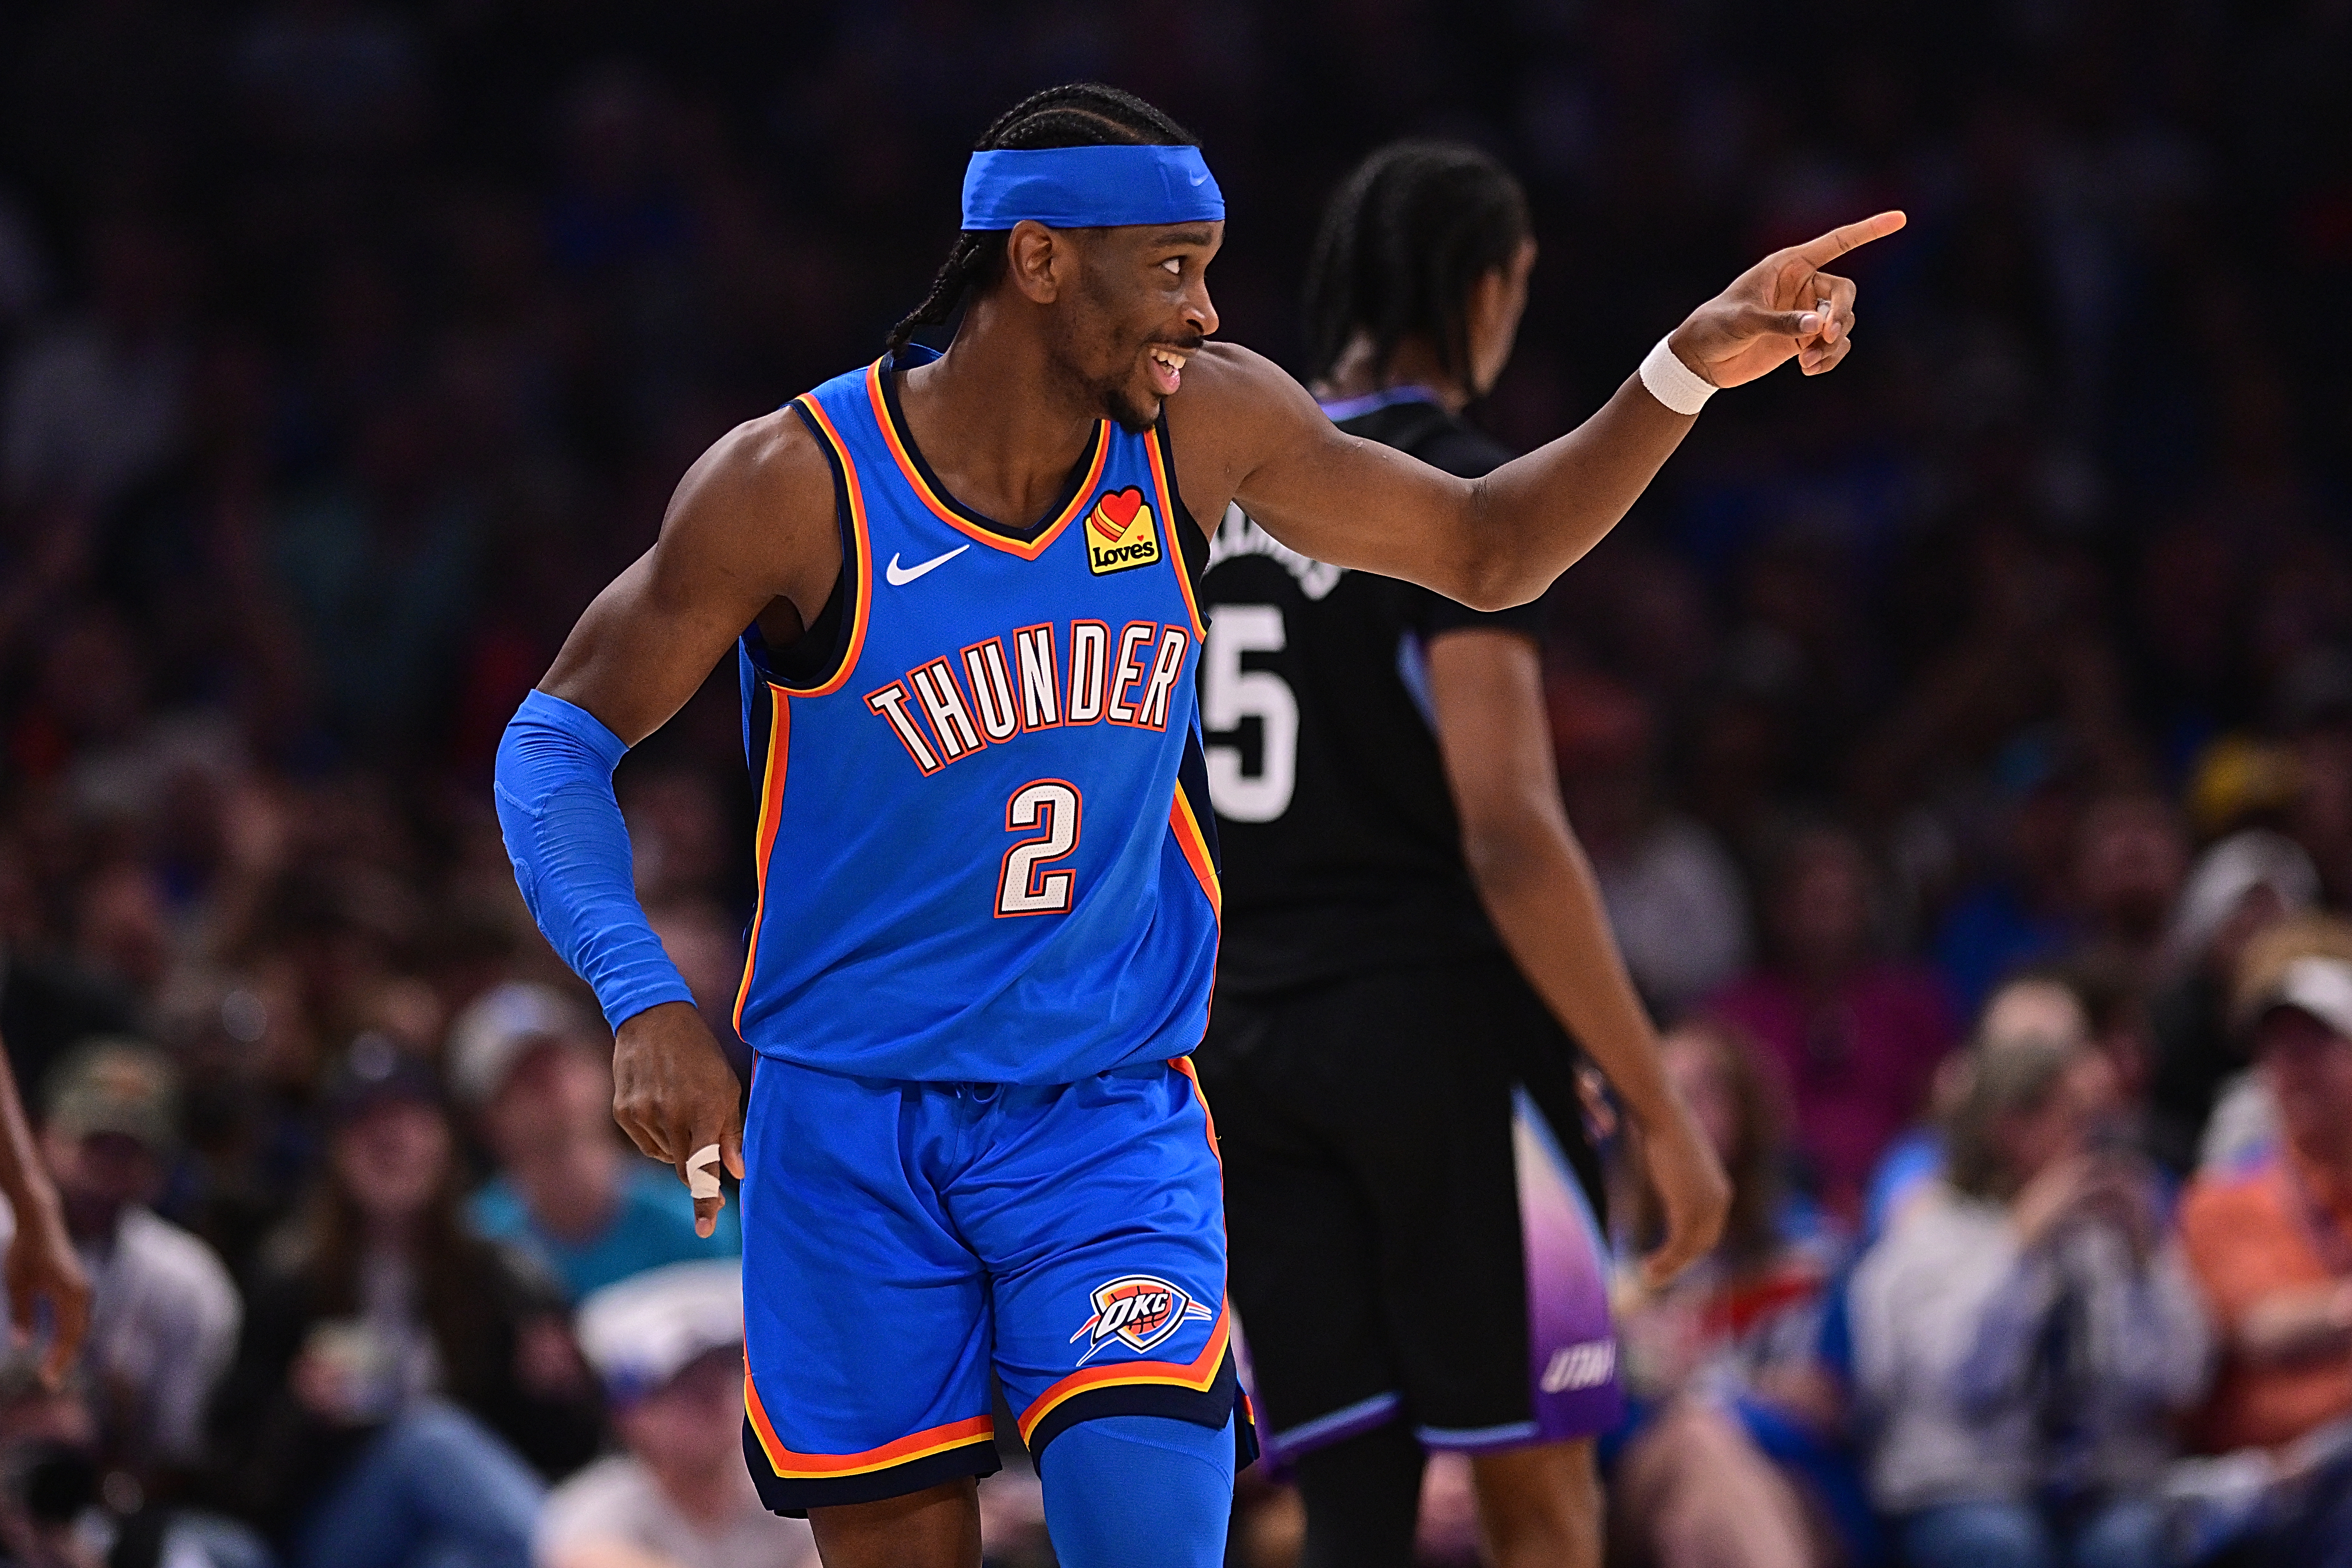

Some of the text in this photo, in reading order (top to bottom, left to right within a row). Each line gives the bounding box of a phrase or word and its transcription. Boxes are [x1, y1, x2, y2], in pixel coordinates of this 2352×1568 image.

[863, 619, 1190, 777] THUNDER
[1203, 604, 1300, 822] 5
[994, 777, 1082, 919] 2
[1094, 1293, 1169, 1340] OKC
